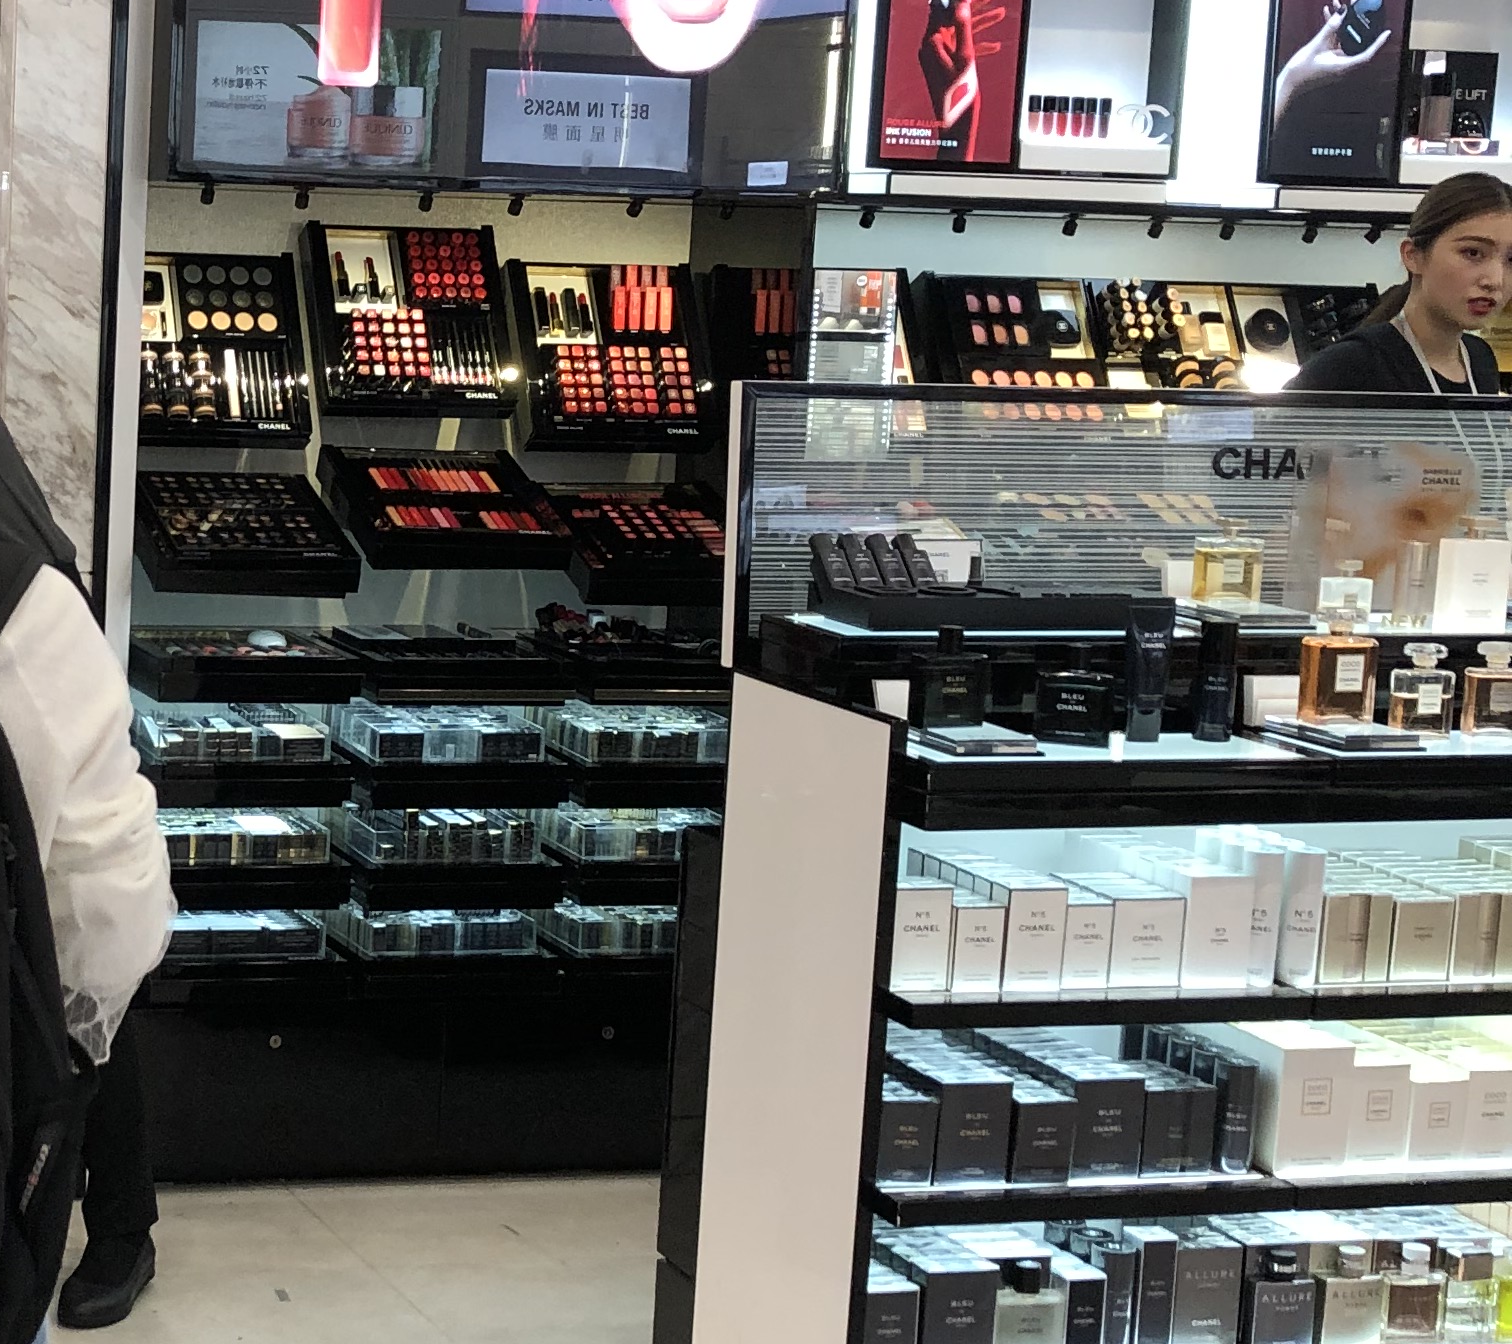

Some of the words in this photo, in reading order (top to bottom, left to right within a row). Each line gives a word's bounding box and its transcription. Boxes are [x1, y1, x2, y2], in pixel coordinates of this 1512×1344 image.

[1465, 88, 1488, 101] LIFT
[901, 127, 932, 137] FUSION
[464, 391, 499, 400] CHANEL
[257, 422, 291, 431] CHANEL
[667, 427, 700, 436] CHANEL
[1421, 476, 1461, 486] CHANEL
[1381, 614, 1428, 629] NEW
[1060, 692, 1085, 701] BLEU
[1055, 704, 1088, 713] CHANEL
[903, 924, 941, 933] CHANEL
[1018, 924, 1056, 932] CHANEL
[1185, 1269, 1236, 1280] ALLURE
[1261, 1292, 1313, 1304] ALLURE
[1331, 1288, 1381, 1299] ALLURE
[945, 1315, 976, 1324] CHANEL
[1191, 1319, 1222, 1327] CHANEL
